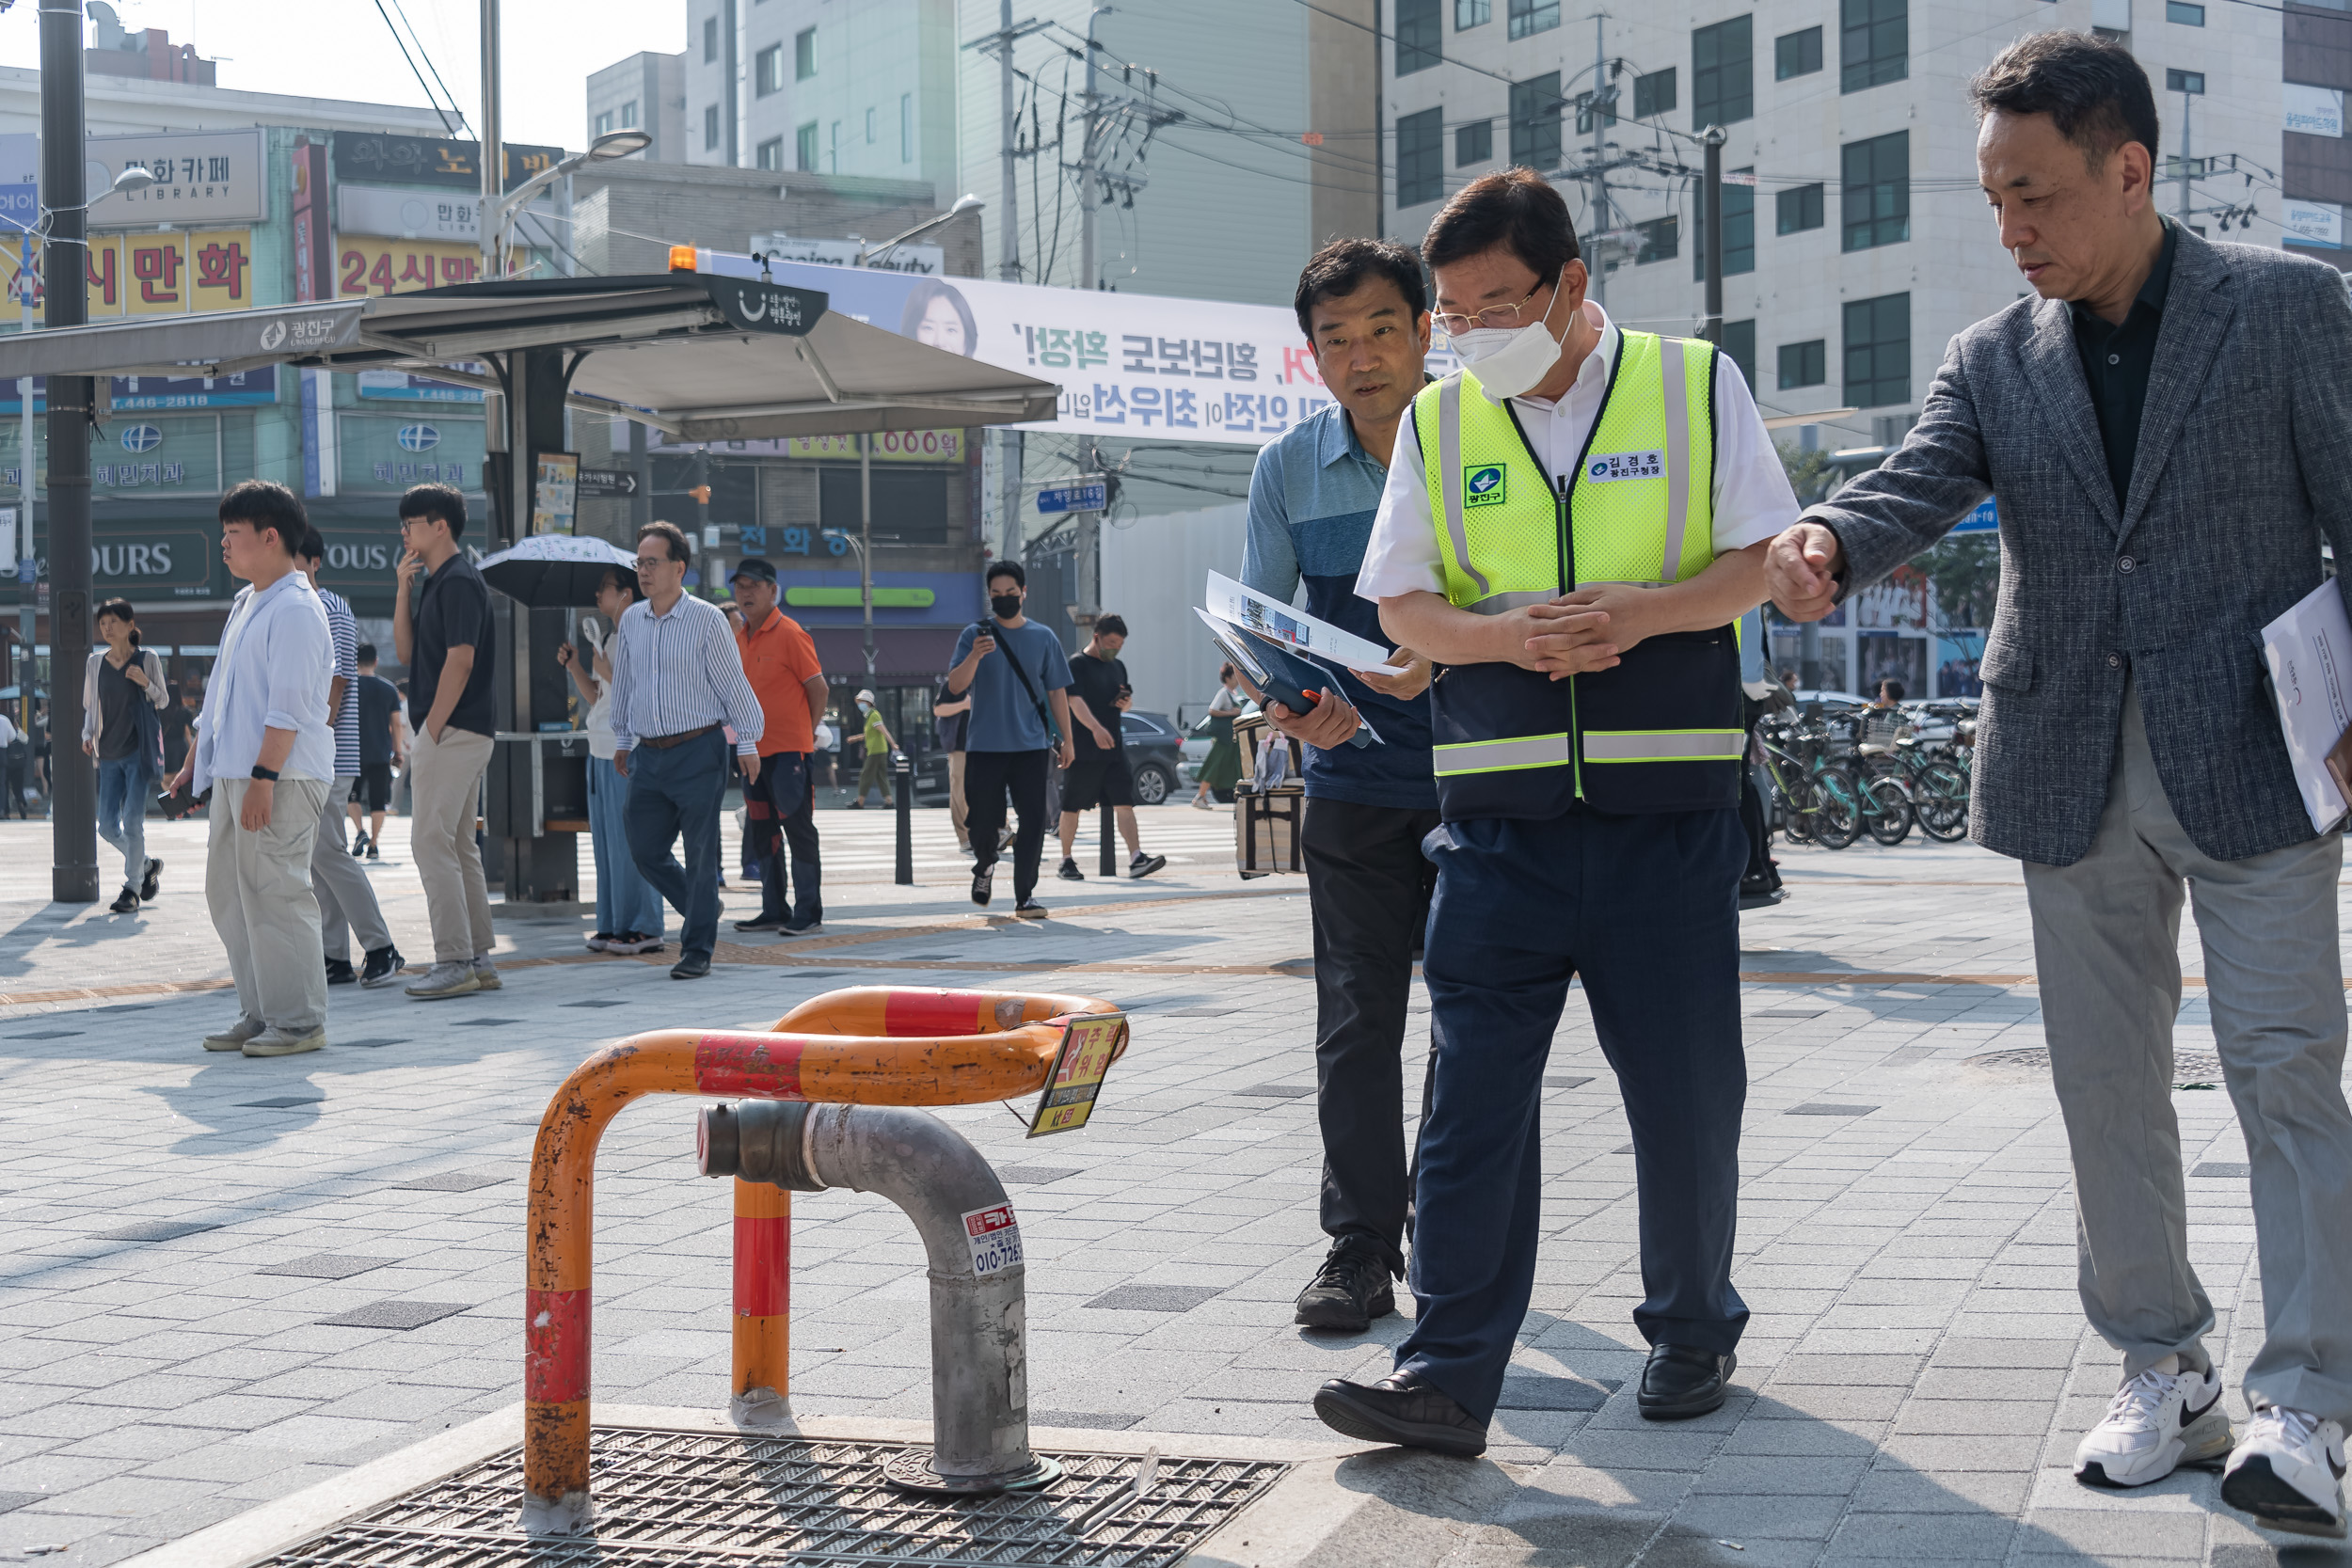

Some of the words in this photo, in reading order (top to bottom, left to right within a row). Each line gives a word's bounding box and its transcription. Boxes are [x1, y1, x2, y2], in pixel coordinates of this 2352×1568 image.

[126, 186, 230, 202] LIBRARY
[291, 318, 334, 339] 광진구
[1610, 465, 1661, 479] 광진구청장
[1468, 491, 1502, 504] 광진구
